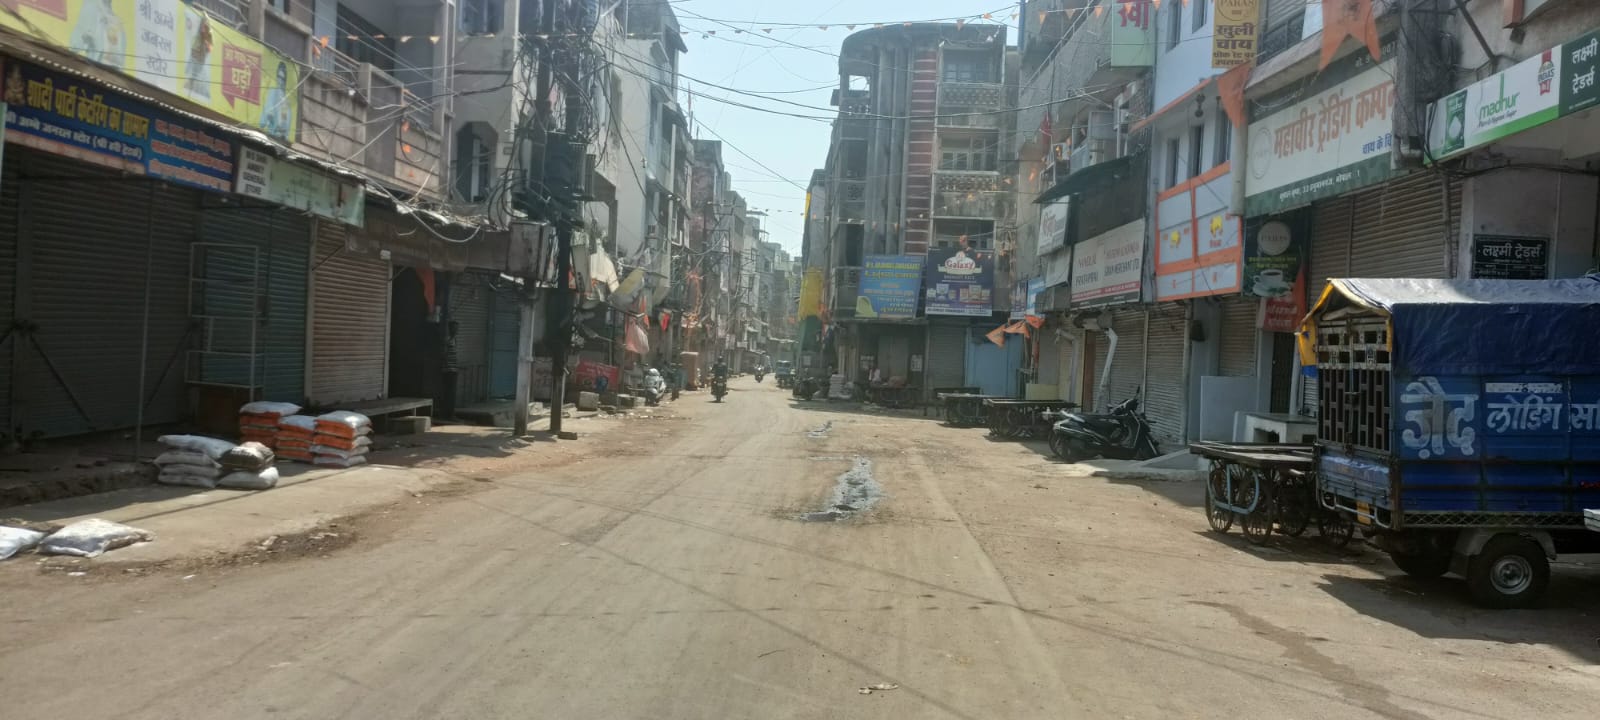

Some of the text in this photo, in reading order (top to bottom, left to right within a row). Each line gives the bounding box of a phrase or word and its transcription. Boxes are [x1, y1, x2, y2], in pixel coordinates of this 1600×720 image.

[1216, 23, 1255, 38] खुली
[1216, 39, 1255, 50] चाय
[1572, 38, 1599, 64] लक्ष्मी
[1572, 65, 1595, 94] ट्रेडर्स
[1479, 72, 1520, 121] madhur
[1274, 107, 1316, 159] महावीर
[1317, 88, 1354, 154] ट्रेडिंग
[1483, 243, 1544, 259] लक्ष्मी ट्रेडर्स
[946, 259, 974, 270] Galaxy
[1486, 394, 1562, 433] लोडिंग
